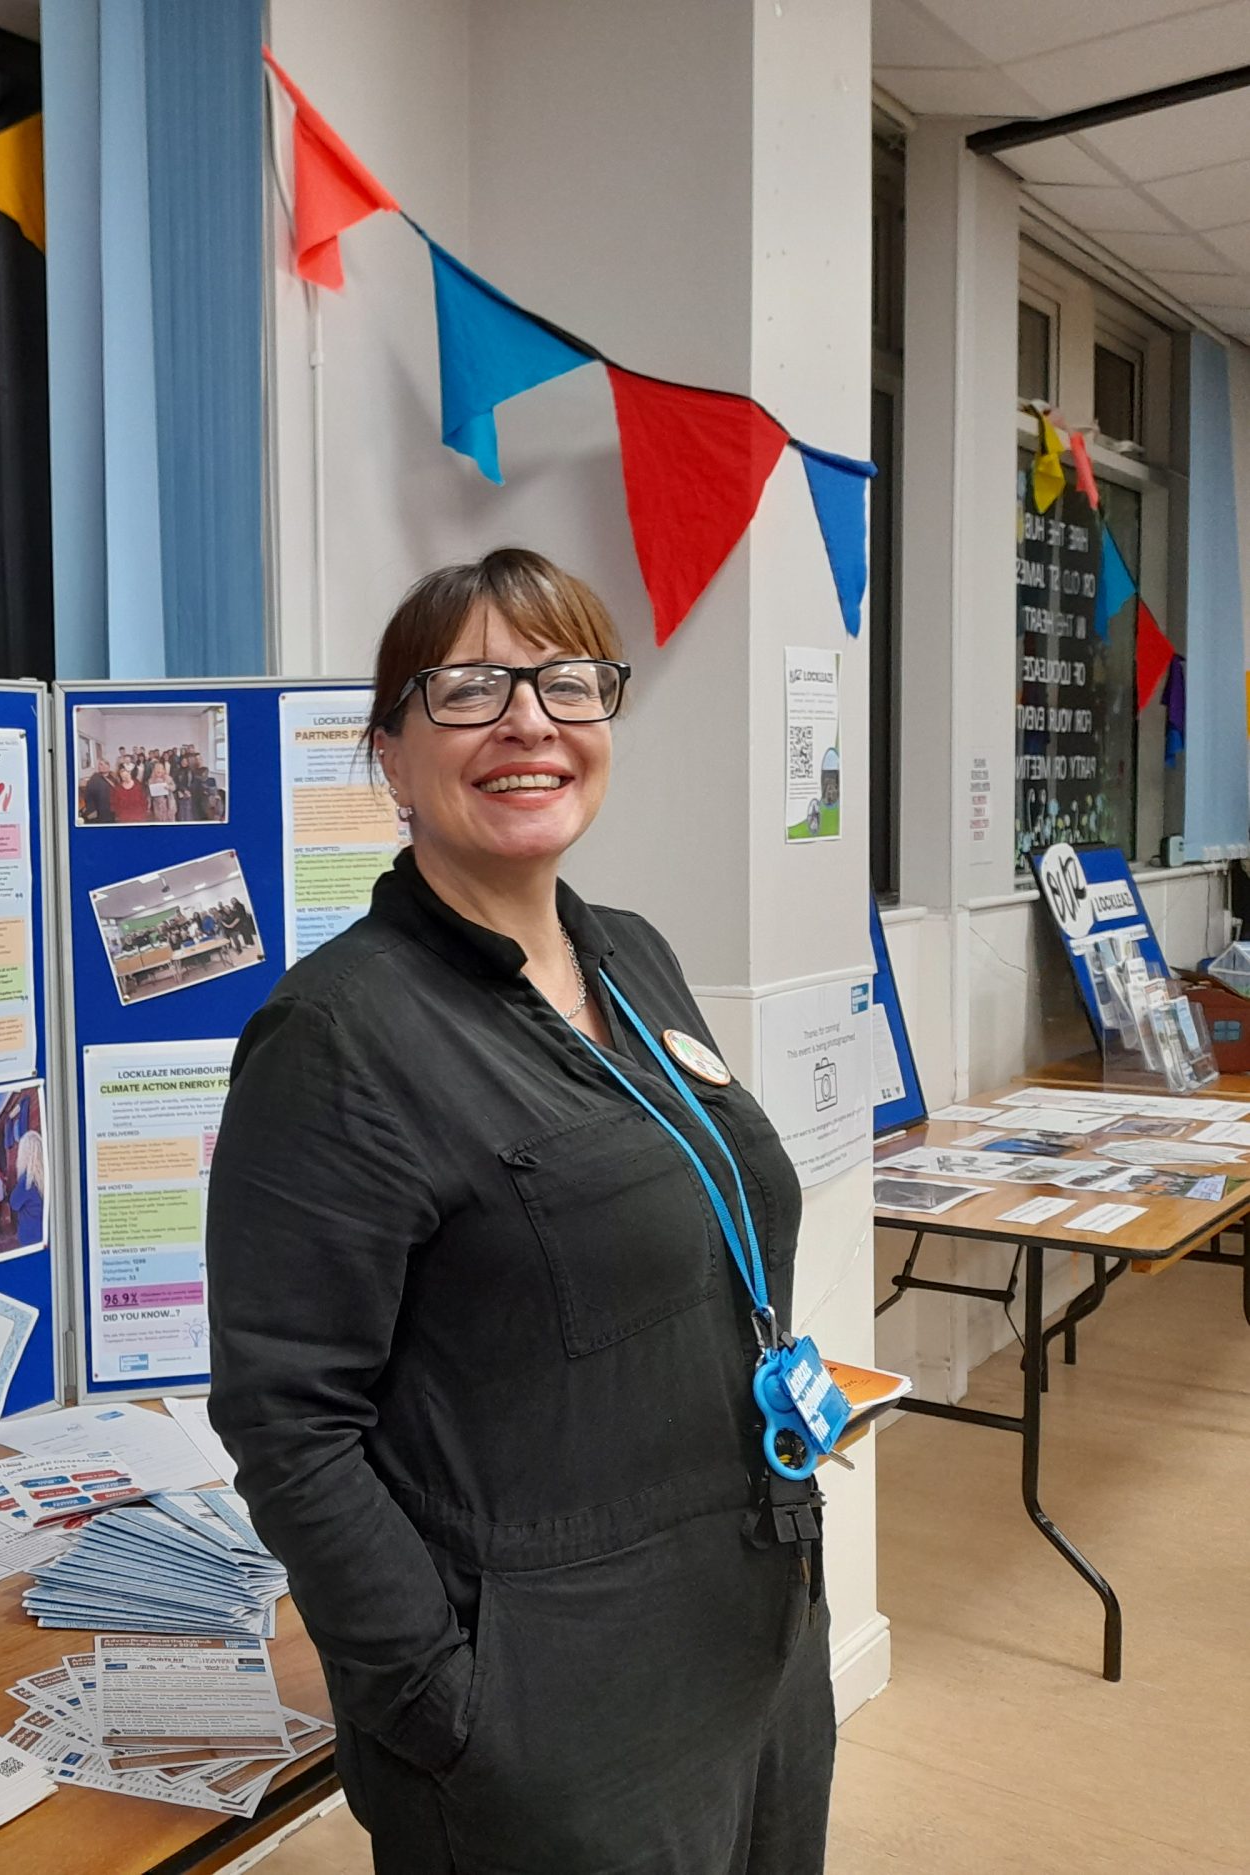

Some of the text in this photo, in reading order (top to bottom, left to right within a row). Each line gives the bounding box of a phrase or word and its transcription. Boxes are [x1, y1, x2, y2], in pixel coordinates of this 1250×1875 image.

[313, 716, 364, 725] LOCKLEAZE
[295, 731, 349, 740] PARTNERS
[118, 1066, 230, 1079] LOCKLEAZE NEIGHBOURH
[100, 1079, 230, 1094] CLIMATE ACTION ENERGY FO
[103, 1313, 118, 1322] DID
[120, 1312, 139, 1321] YOU
